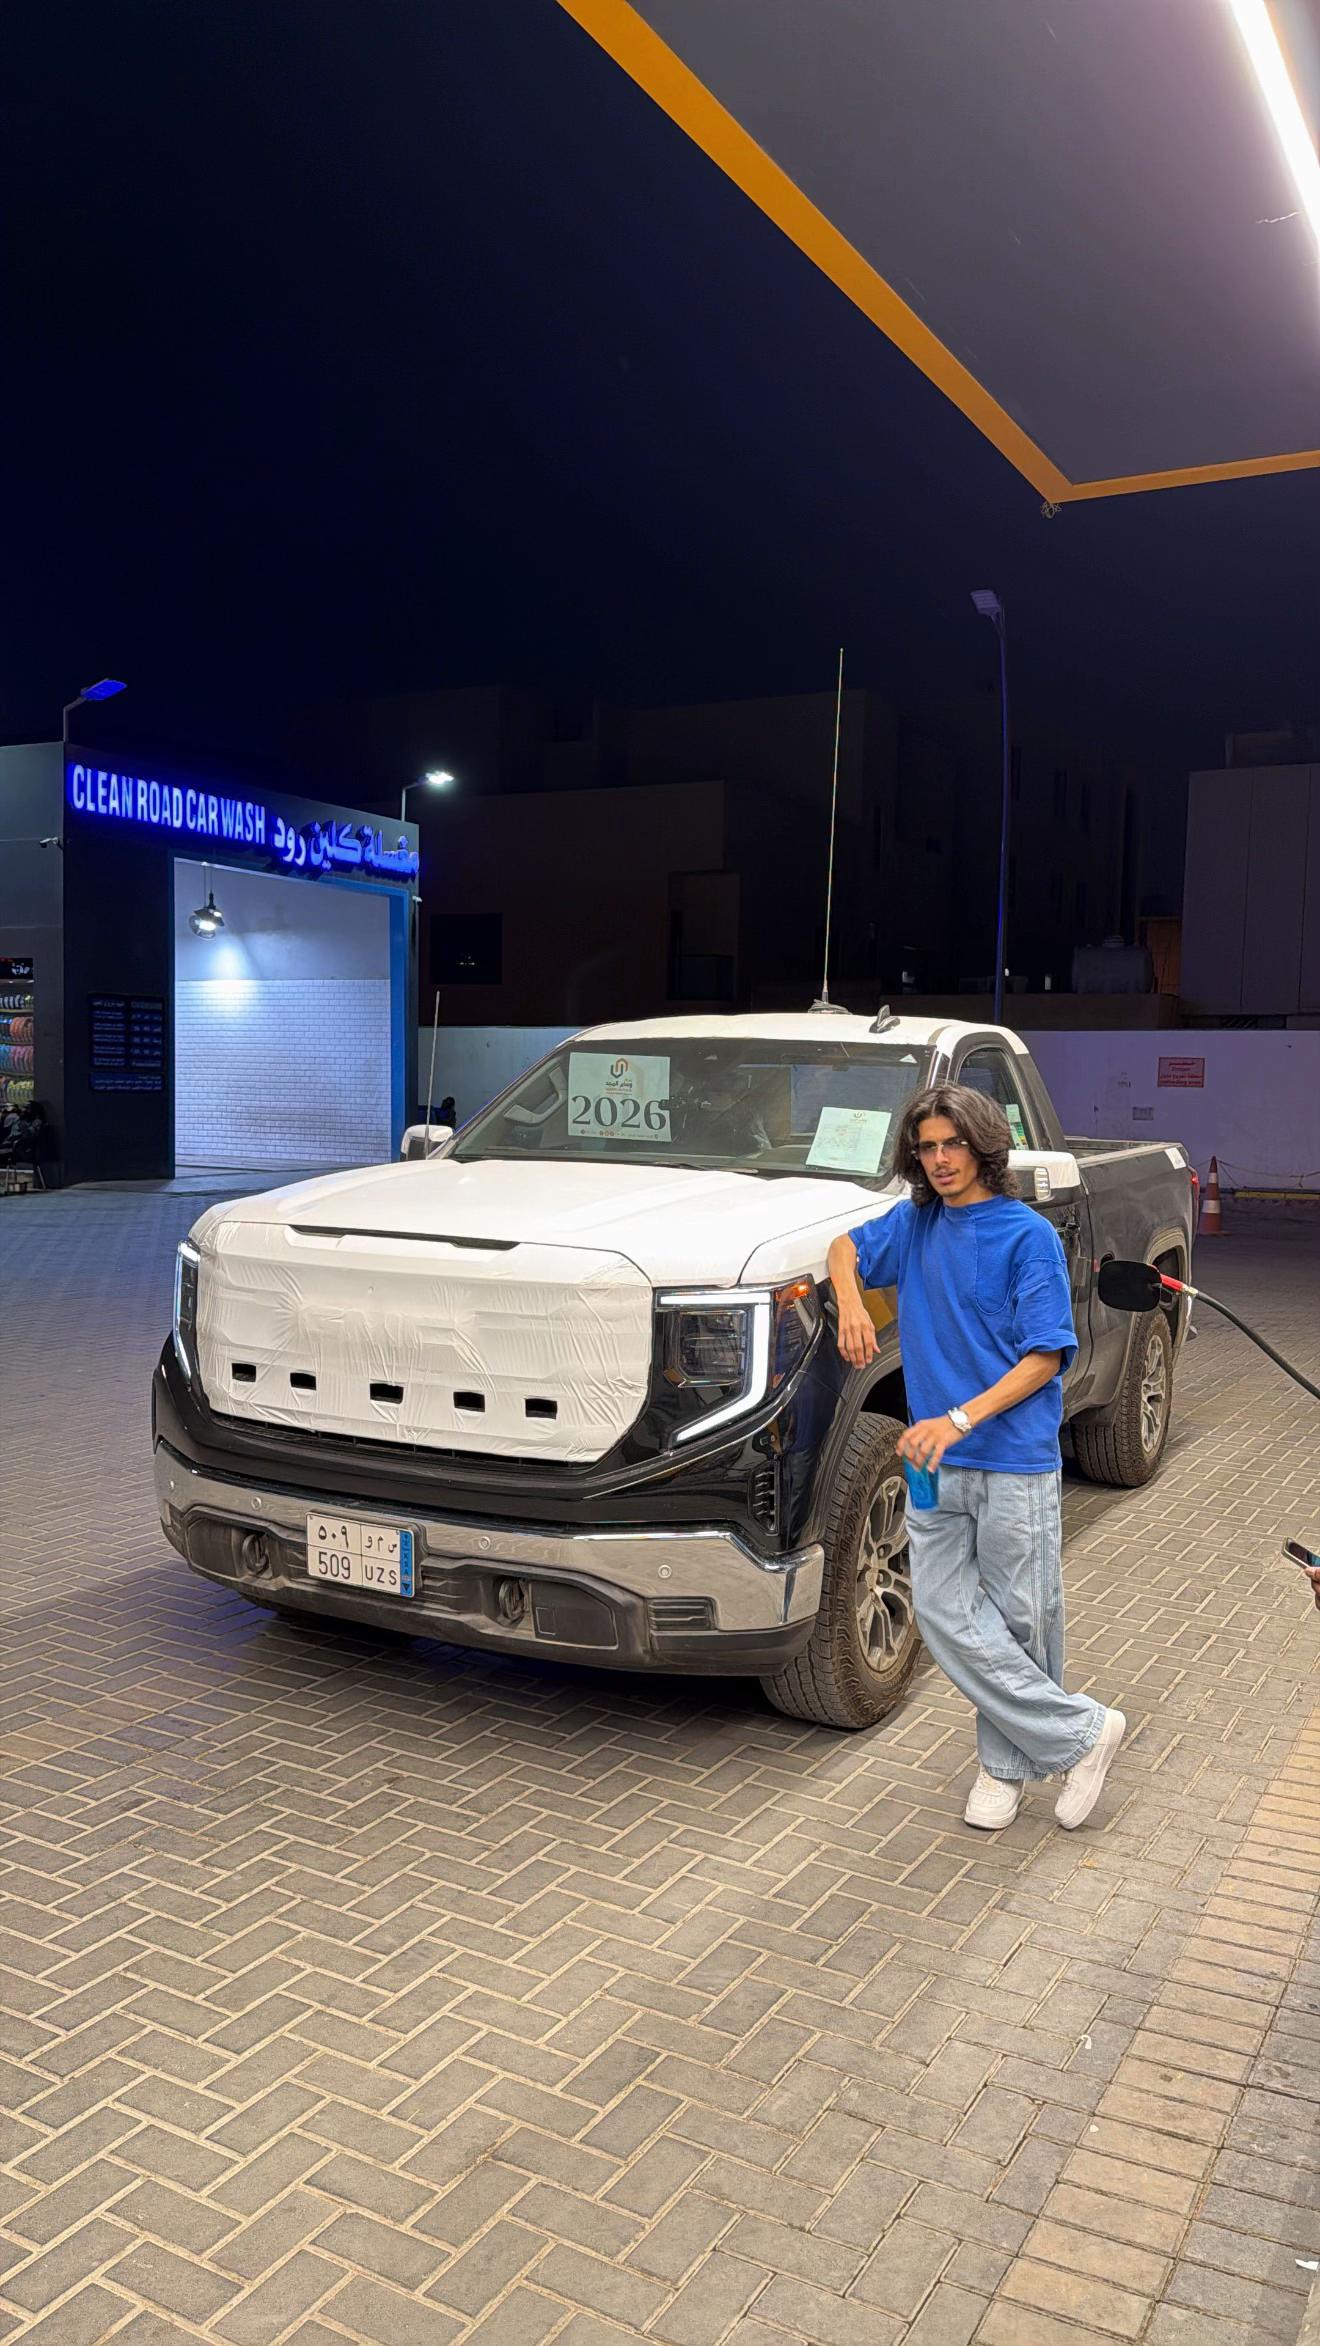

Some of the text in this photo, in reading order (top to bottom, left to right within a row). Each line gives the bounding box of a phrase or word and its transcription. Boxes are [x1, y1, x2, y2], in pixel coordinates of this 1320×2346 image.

[72, 764, 266, 845] CLEAN ROAD CAR WASH
[274, 817, 419, 874] مغسلة كلين رود
[571, 1095, 667, 1131] 2026
[318, 1551, 351, 1579] 509
[365, 1564, 397, 1586] UZS
